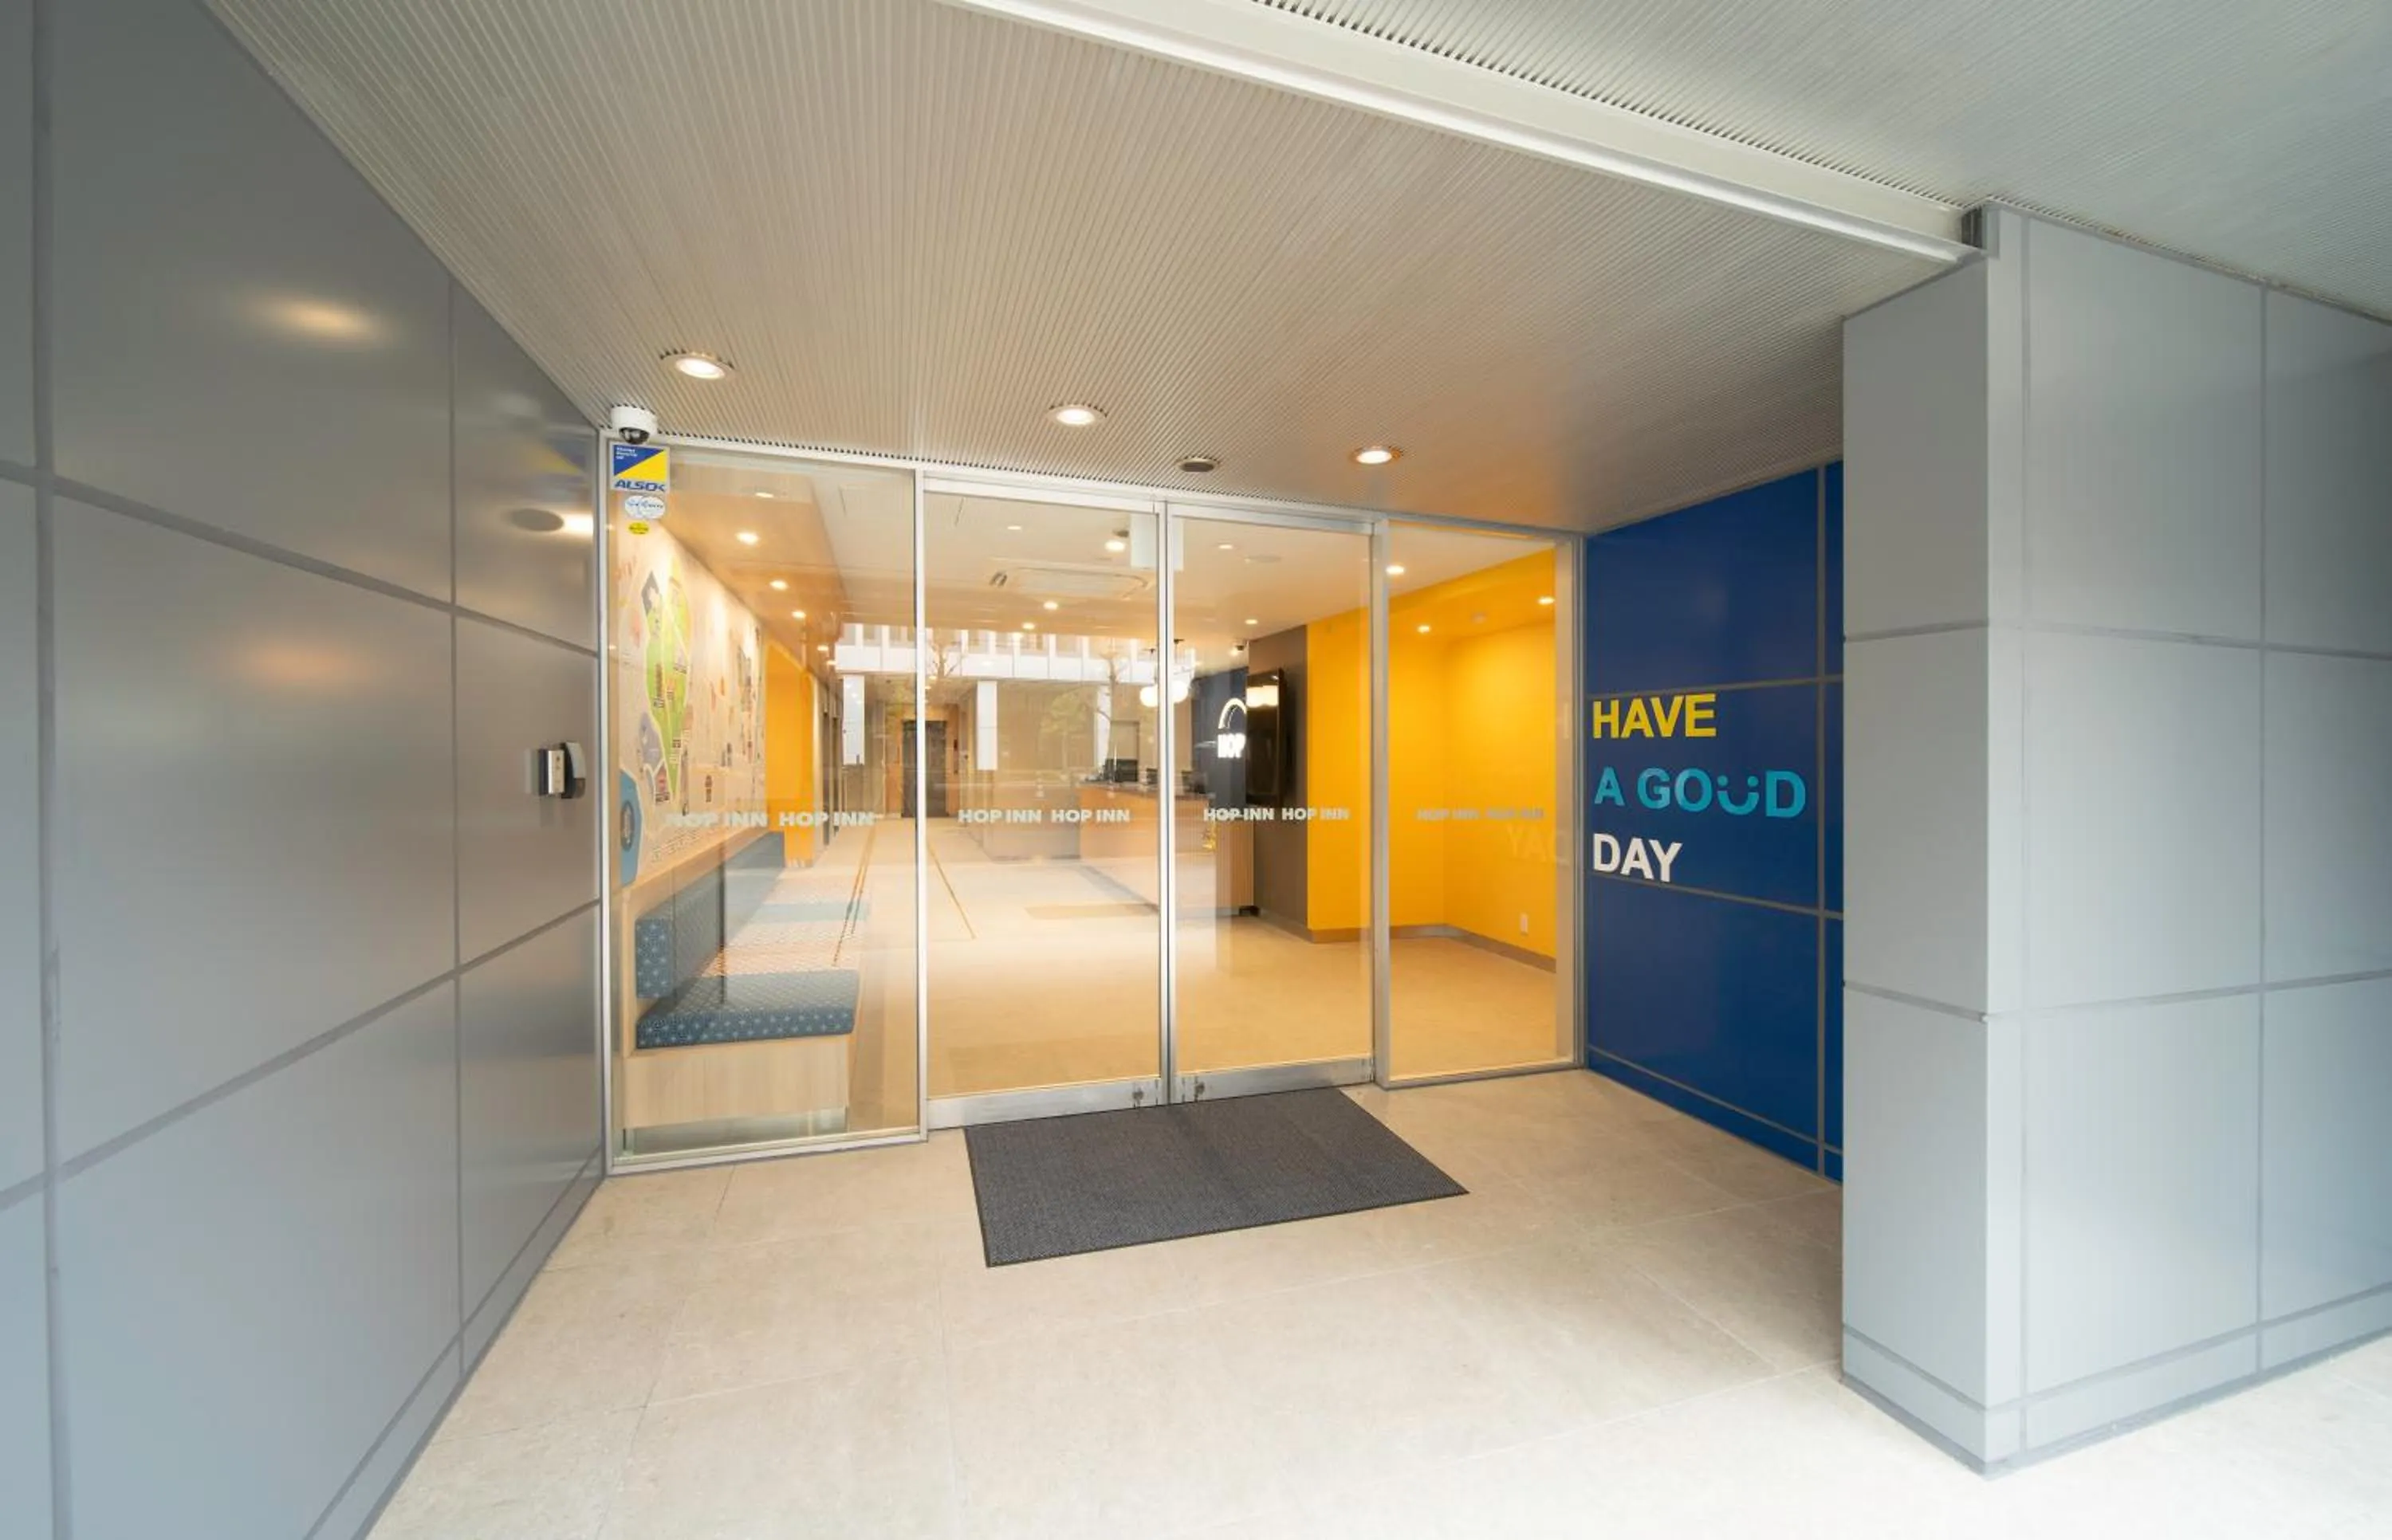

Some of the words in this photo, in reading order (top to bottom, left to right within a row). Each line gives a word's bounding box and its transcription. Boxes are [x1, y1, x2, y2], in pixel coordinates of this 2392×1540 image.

[614, 479, 666, 492] ALSOK
[1592, 693, 1717, 739] HAVE
[1595, 766, 1624, 806] A
[726, 811, 768, 827] INN
[779, 811, 830, 827] HOP
[834, 811, 875, 826] INN
[958, 809, 1003, 823] HOP
[1005, 809, 1042, 823] INN
[1051, 809, 1092, 823] HOP
[1096, 809, 1131, 823] INN
[1204, 807, 1240, 821] HOP
[1243, 807, 1275, 820] INN
[1281, 807, 1317, 820] HOP
[1592, 833, 1682, 882] DAY
